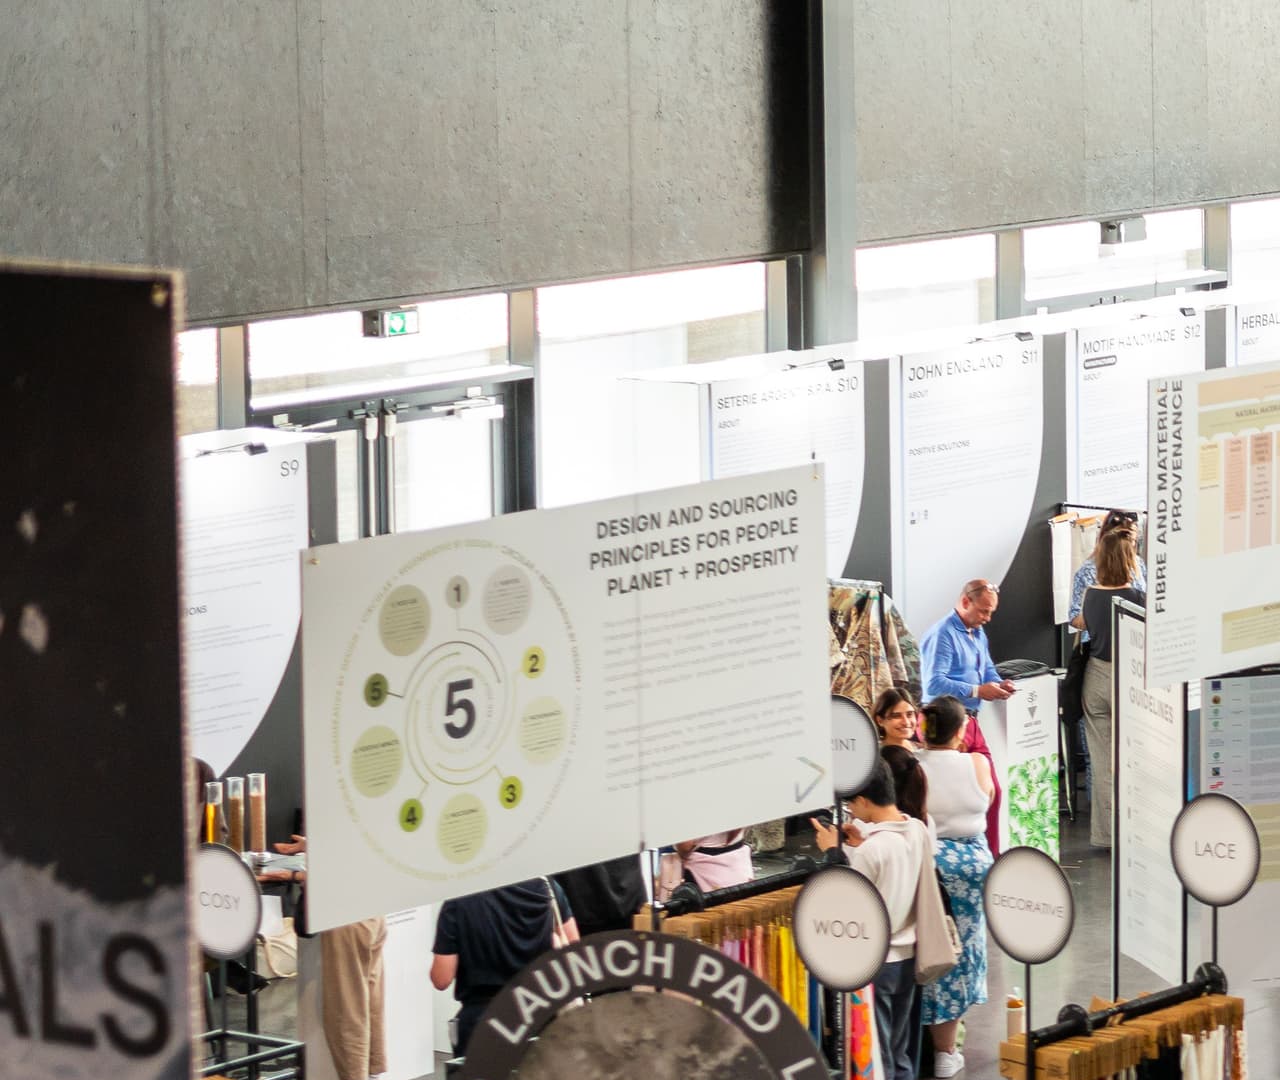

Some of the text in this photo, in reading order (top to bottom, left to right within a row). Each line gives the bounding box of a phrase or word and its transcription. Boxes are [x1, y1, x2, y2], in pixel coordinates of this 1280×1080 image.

[1184, 324, 1201, 339] S12
[1241, 313, 1280, 331] HERBAL
[1083, 336, 1116, 356] MOTIF
[1021, 350, 1038, 365] S11
[908, 354, 1004, 382] JOHN ENGLAND
[837, 375, 858, 393] S10
[717, 392, 757, 410] SETERIE
[1171, 379, 1183, 532] PROVENANCE
[280, 459, 300, 477] S9
[1154, 380, 1168, 614] FIBRE AND MATERIAL
[596, 488, 798, 540] DESIGN AND SOURCING
[589, 516, 799, 571] PRINCIPLES FOR PEOPLE
[607, 567, 673, 597] PLANET
[695, 544, 800, 581] PROSPERITY
[453, 583, 462, 603] 1
[527, 654, 540, 674] 2
[370, 682, 382, 697] 5
[443, 678, 476, 740] 5
[1129, 686, 1174, 725] GUIDELINES
[506, 784, 517, 803] 3
[406, 807, 417, 825] 4
[1194, 840, 1237, 860] LACE
[200, 891, 241, 911] COSY
[992, 893, 1066, 919] DECORATIVE
[813, 918, 870, 941] WOOL
[488, 938, 782, 1045] LAUNCH PAD
